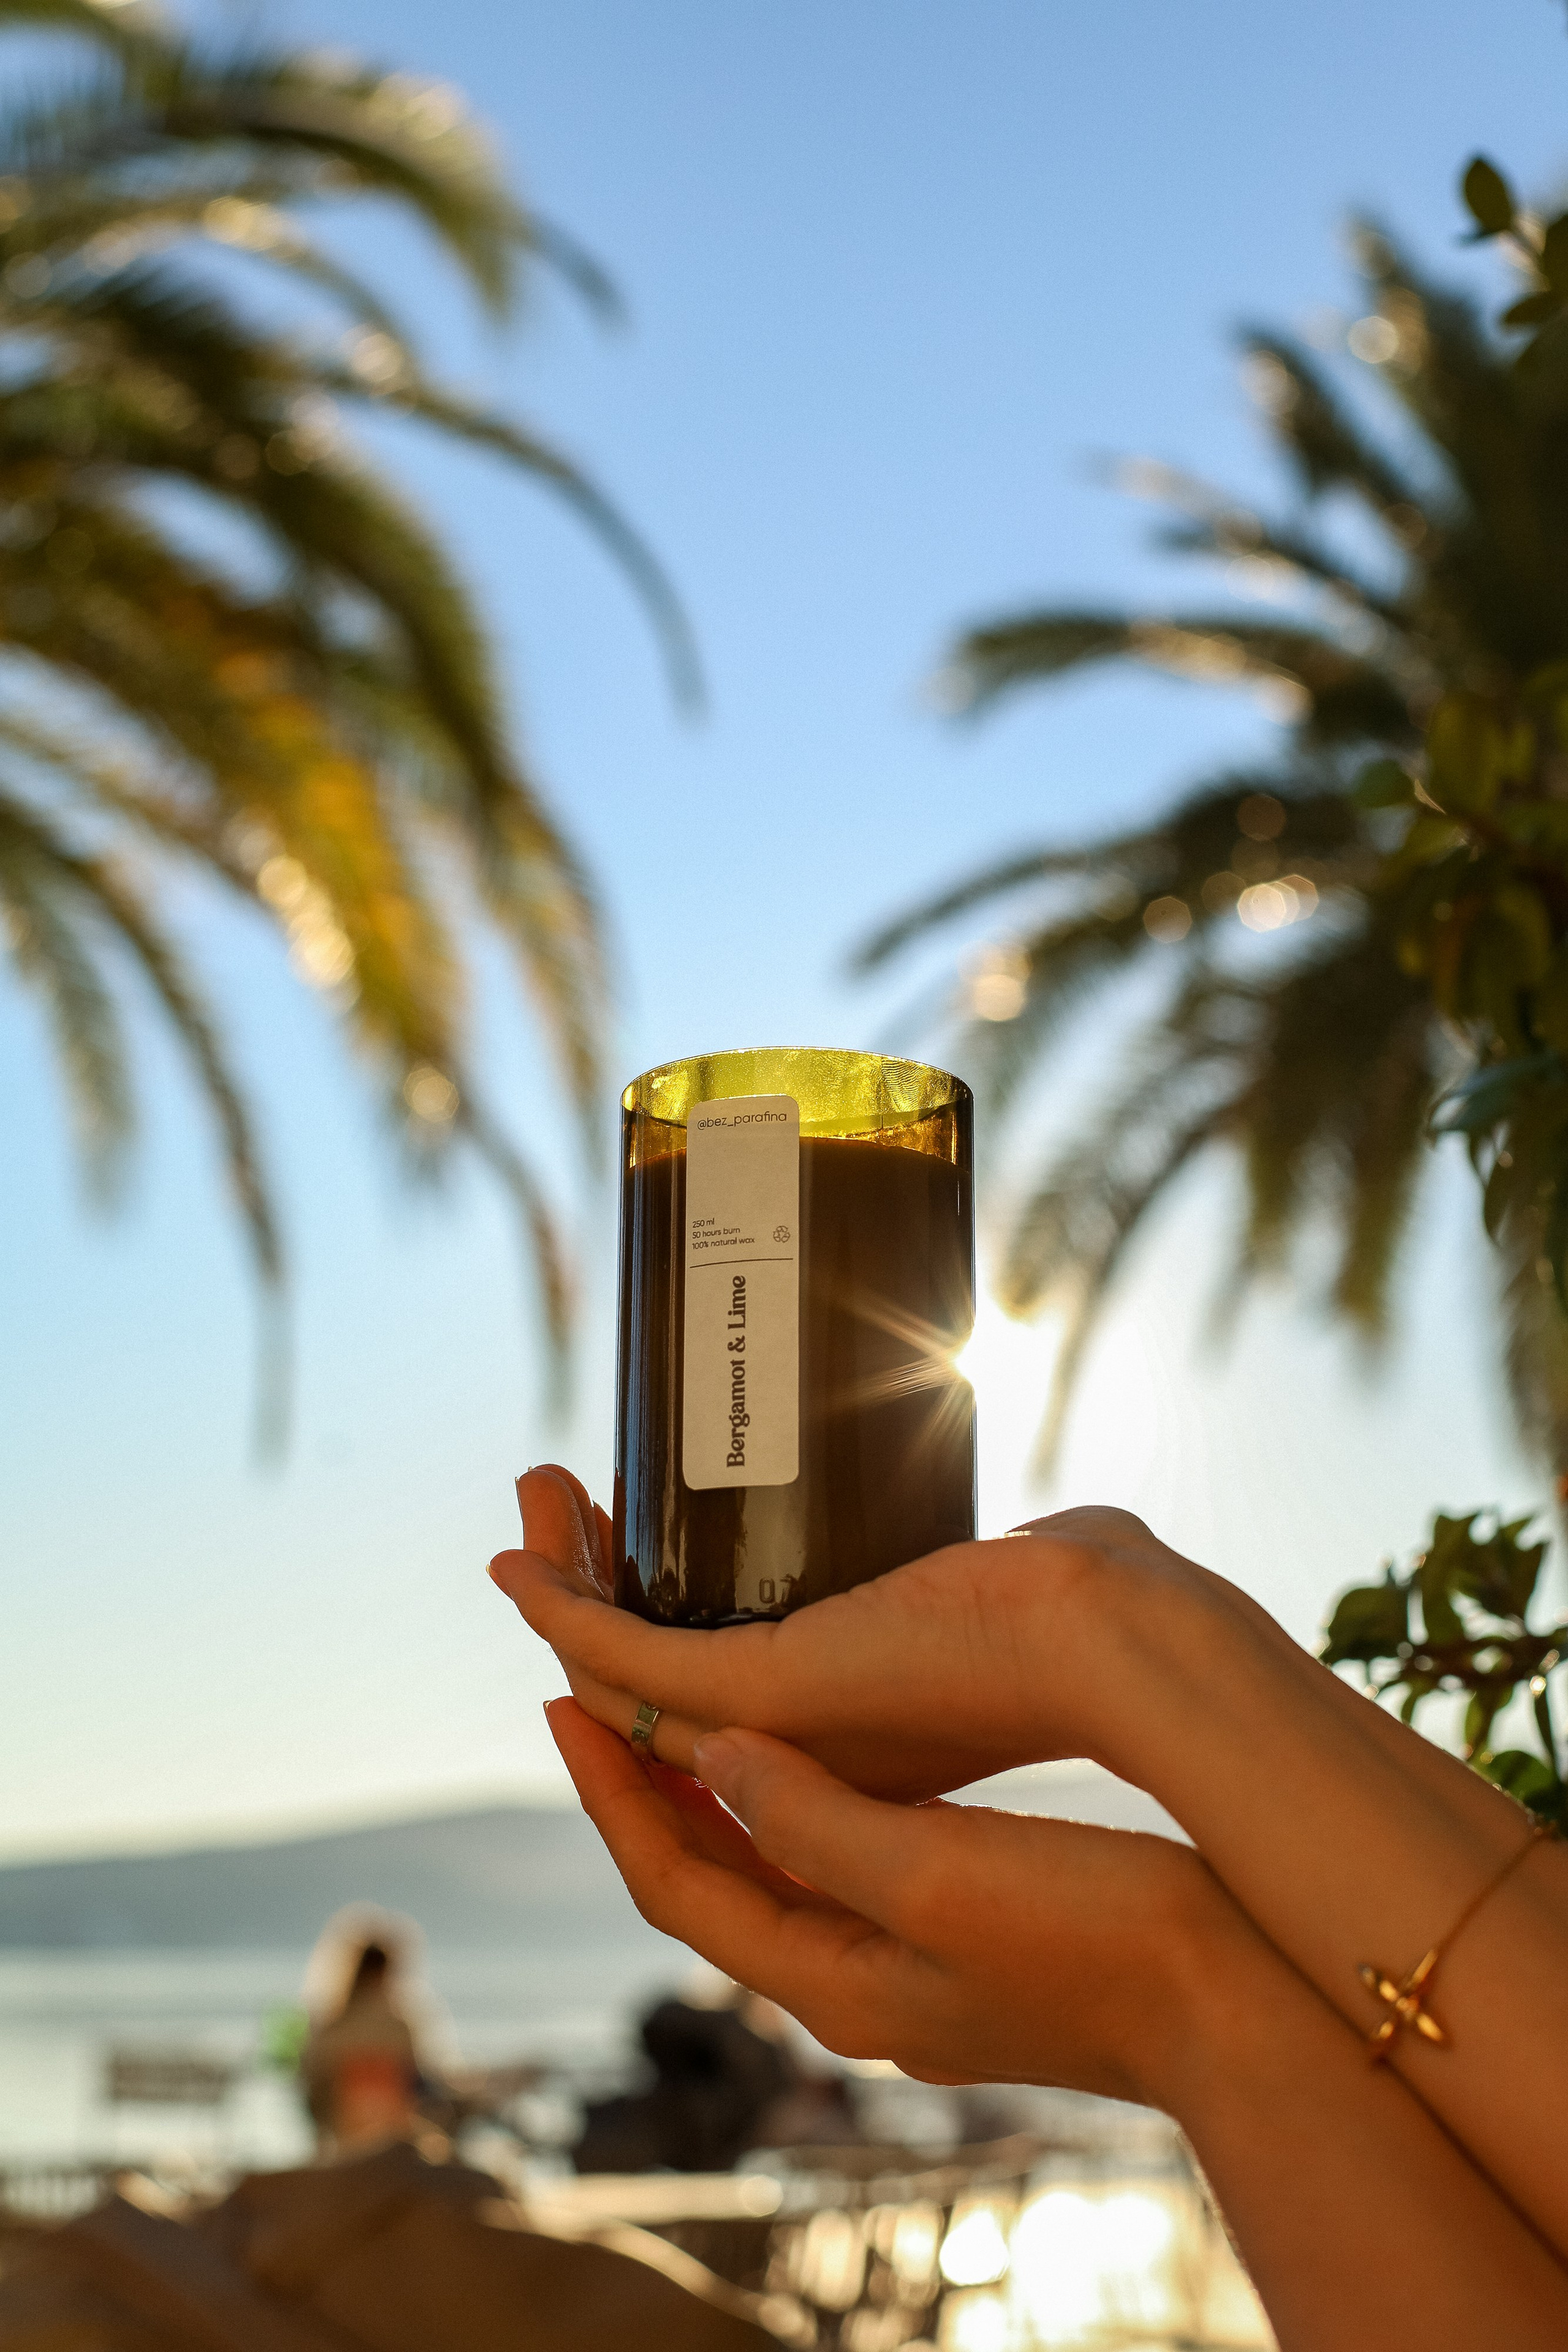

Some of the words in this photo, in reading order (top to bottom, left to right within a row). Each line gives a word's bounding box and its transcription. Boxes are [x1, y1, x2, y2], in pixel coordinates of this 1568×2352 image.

[697, 1110, 787, 1131] @bez_parafina
[692, 1219, 705, 1228] 250
[703, 1229, 722, 1237] hours
[692, 1241, 709, 1250] 100%
[710, 1237, 737, 1247] natural
[727, 1275, 747, 1330] Lime
[727, 1335, 746, 1353] &
[726, 1359, 750, 1468] Bergamot
